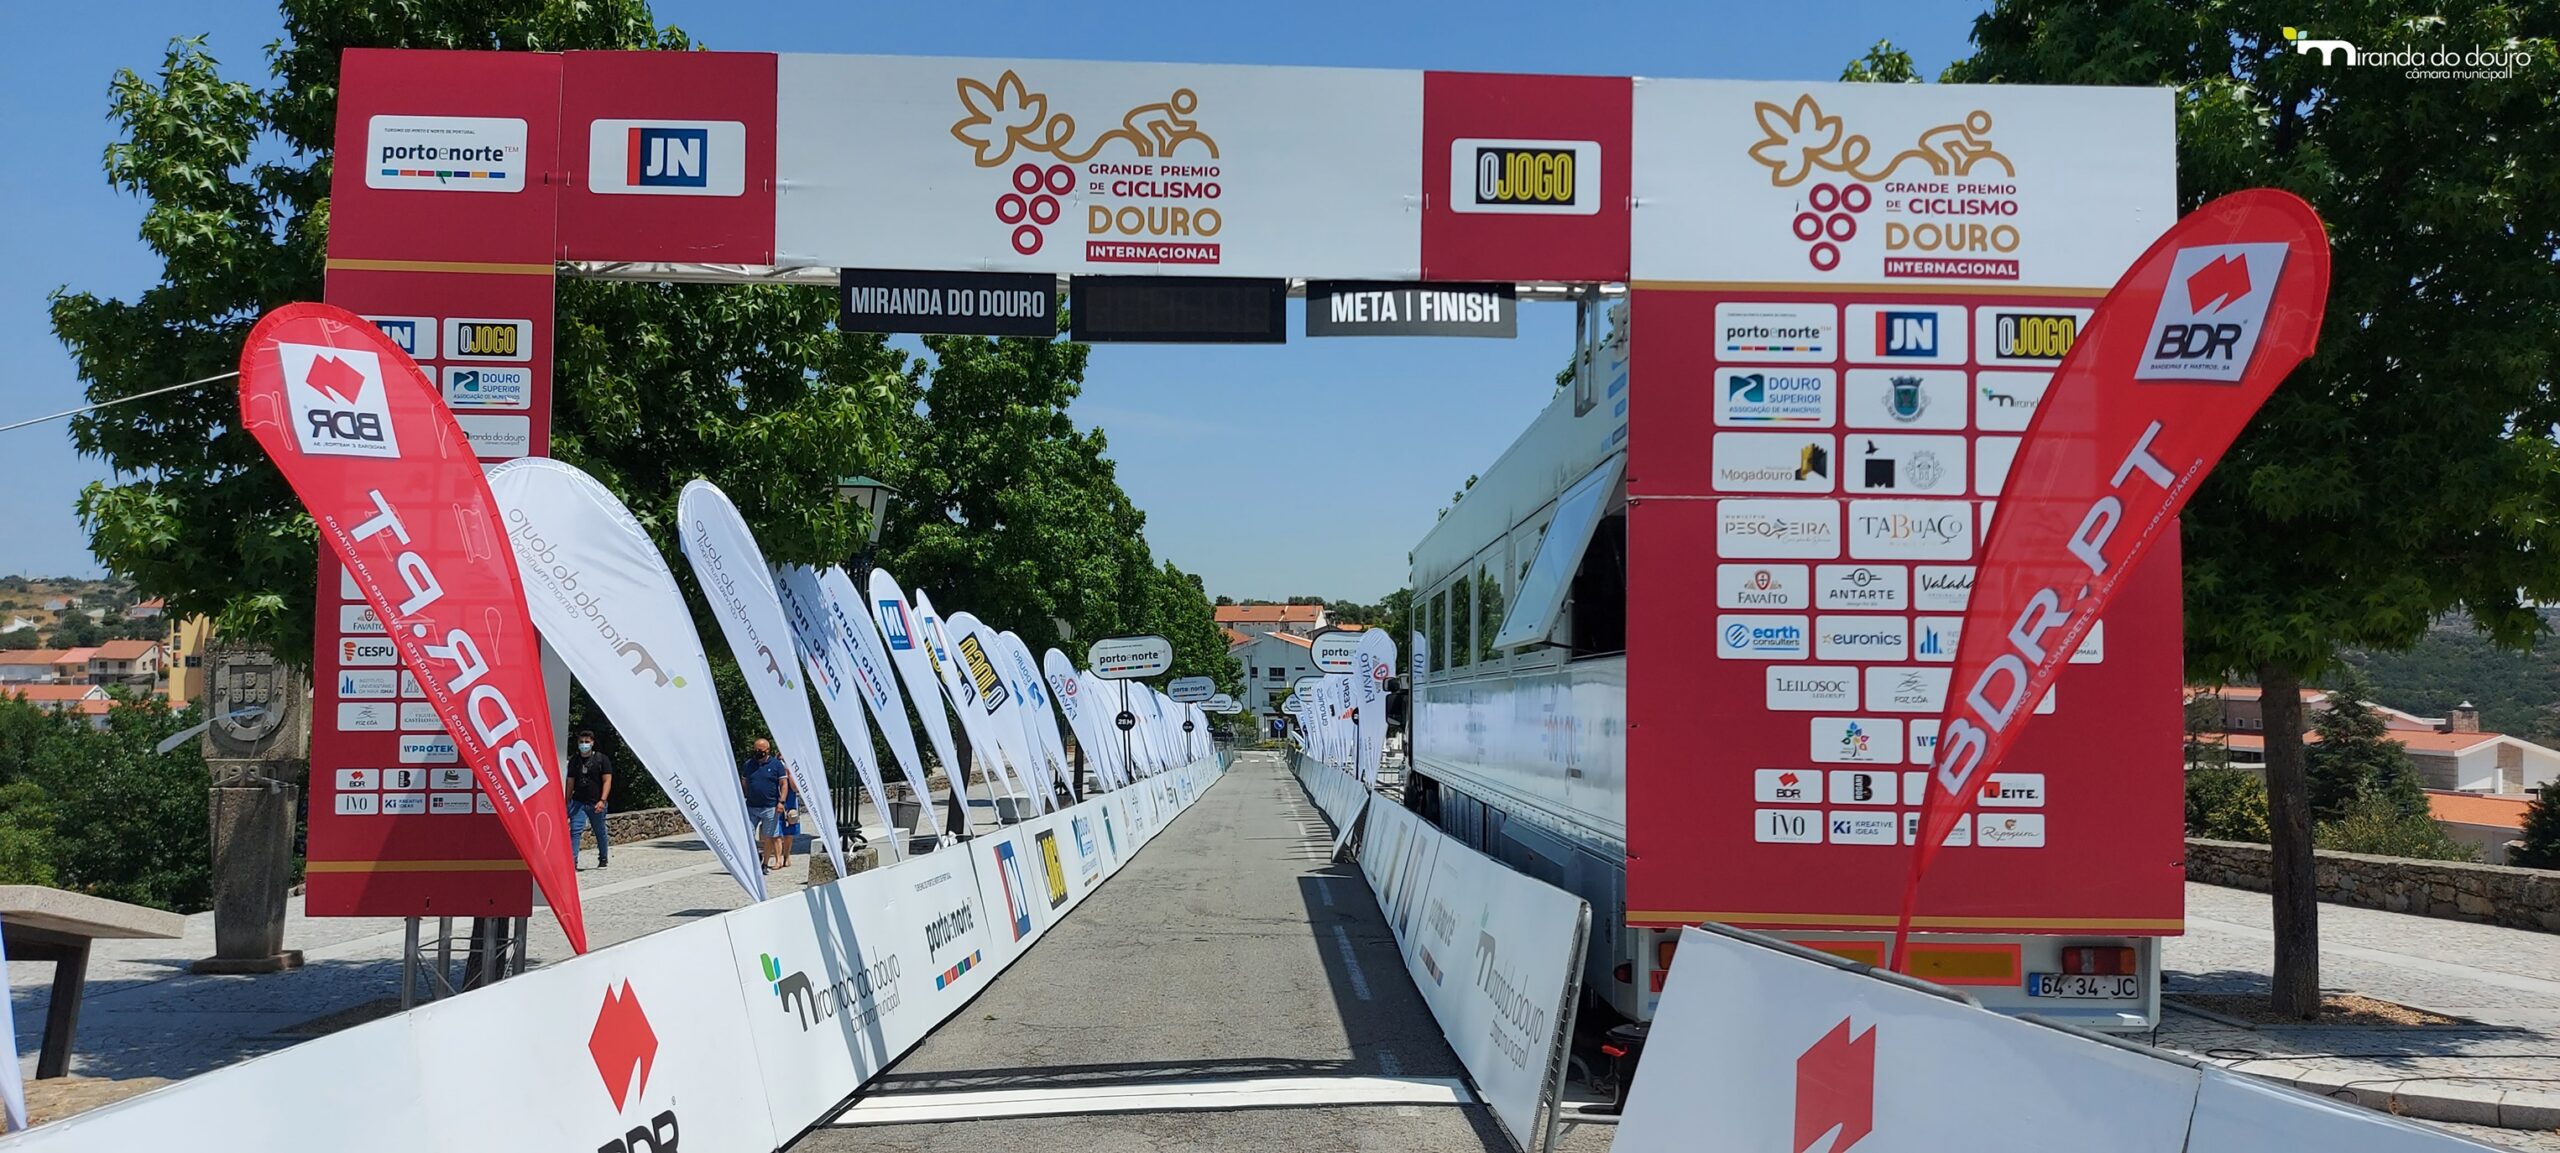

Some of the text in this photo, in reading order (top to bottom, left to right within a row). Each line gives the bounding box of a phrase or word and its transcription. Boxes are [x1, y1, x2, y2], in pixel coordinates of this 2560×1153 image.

[646, 137, 701, 177] JN
[1088, 163, 1153, 175] GRANDE
[1089, 180, 1222, 199] DE CICLISMO
[1884, 182, 1949, 194] GRANDE
[1886, 198, 2018, 216] DE CICLISMO
[1088, 205, 1222, 237] DOURO
[1885, 222, 2020, 253] DOURO
[1089, 245, 1218, 260] INTERNACIONAL
[1887, 261, 2017, 276] INTERNACIONAL
[851, 286, 1046, 318] MIRANDA DO DOURO
[1331, 291, 1398, 323] META
[1420, 291, 1500, 323] FINISH
[1889, 318, 1933, 350] JN
[2154, 323, 2242, 360] BDR
[482, 373, 521, 383] DOURO
[1768, 377, 1822, 390] DOURO
[482, 385, 521, 393] SUPERIOR
[1768, 393, 1822, 404] SUPERIOR
[1728, 405, 1770, 414] ASSOCIAÇÃO
[1721, 469, 1793, 483] Mogadouro
[1738, 591, 1788, 604] FAVAÍTO
[1829, 589, 1895, 600] ANTARTE
[1752, 625, 1800, 638] earth
[1833, 631, 1902, 645] euronics
[2038, 607, 2095, 679] GALHARDETES
[357, 646, 395, 657] CESPU
[1776, 678, 1846, 693] LEILOSOC
[1776, 788, 1801, 798] BDR
[1833, 821, 1852, 834] Ki
